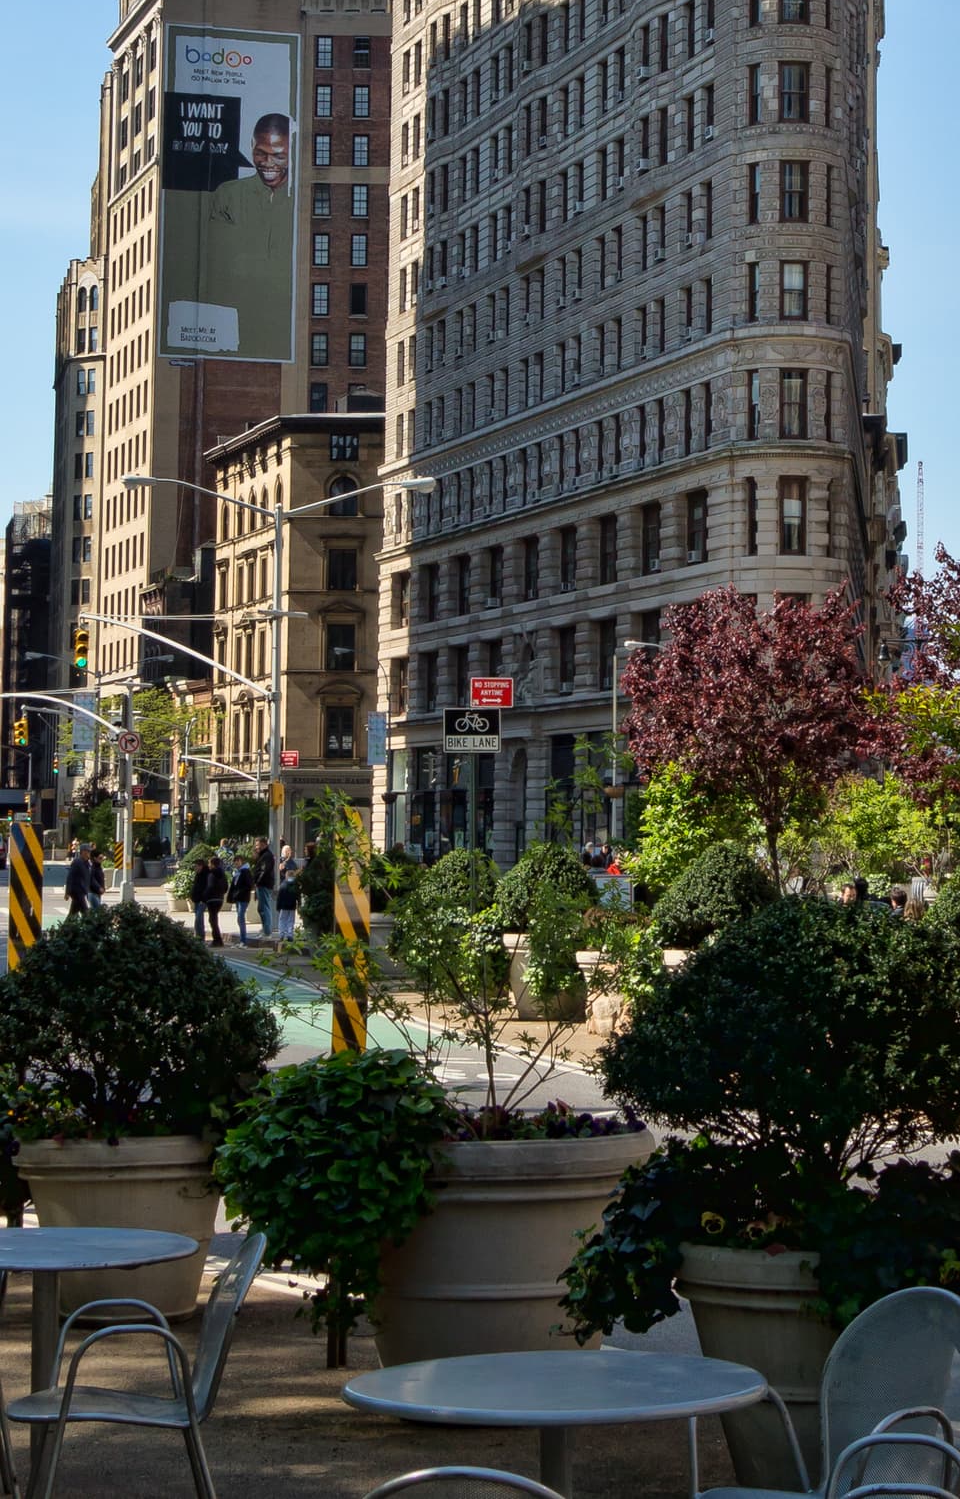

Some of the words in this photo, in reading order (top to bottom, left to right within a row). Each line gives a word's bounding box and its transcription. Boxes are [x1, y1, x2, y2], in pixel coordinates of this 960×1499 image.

[188, 102, 224, 119] WANT
[182, 121, 202, 137] YOU
[208, 122, 222, 139] TO
[447, 737, 468, 747] BIKE
[472, 737, 497, 747] LANE
